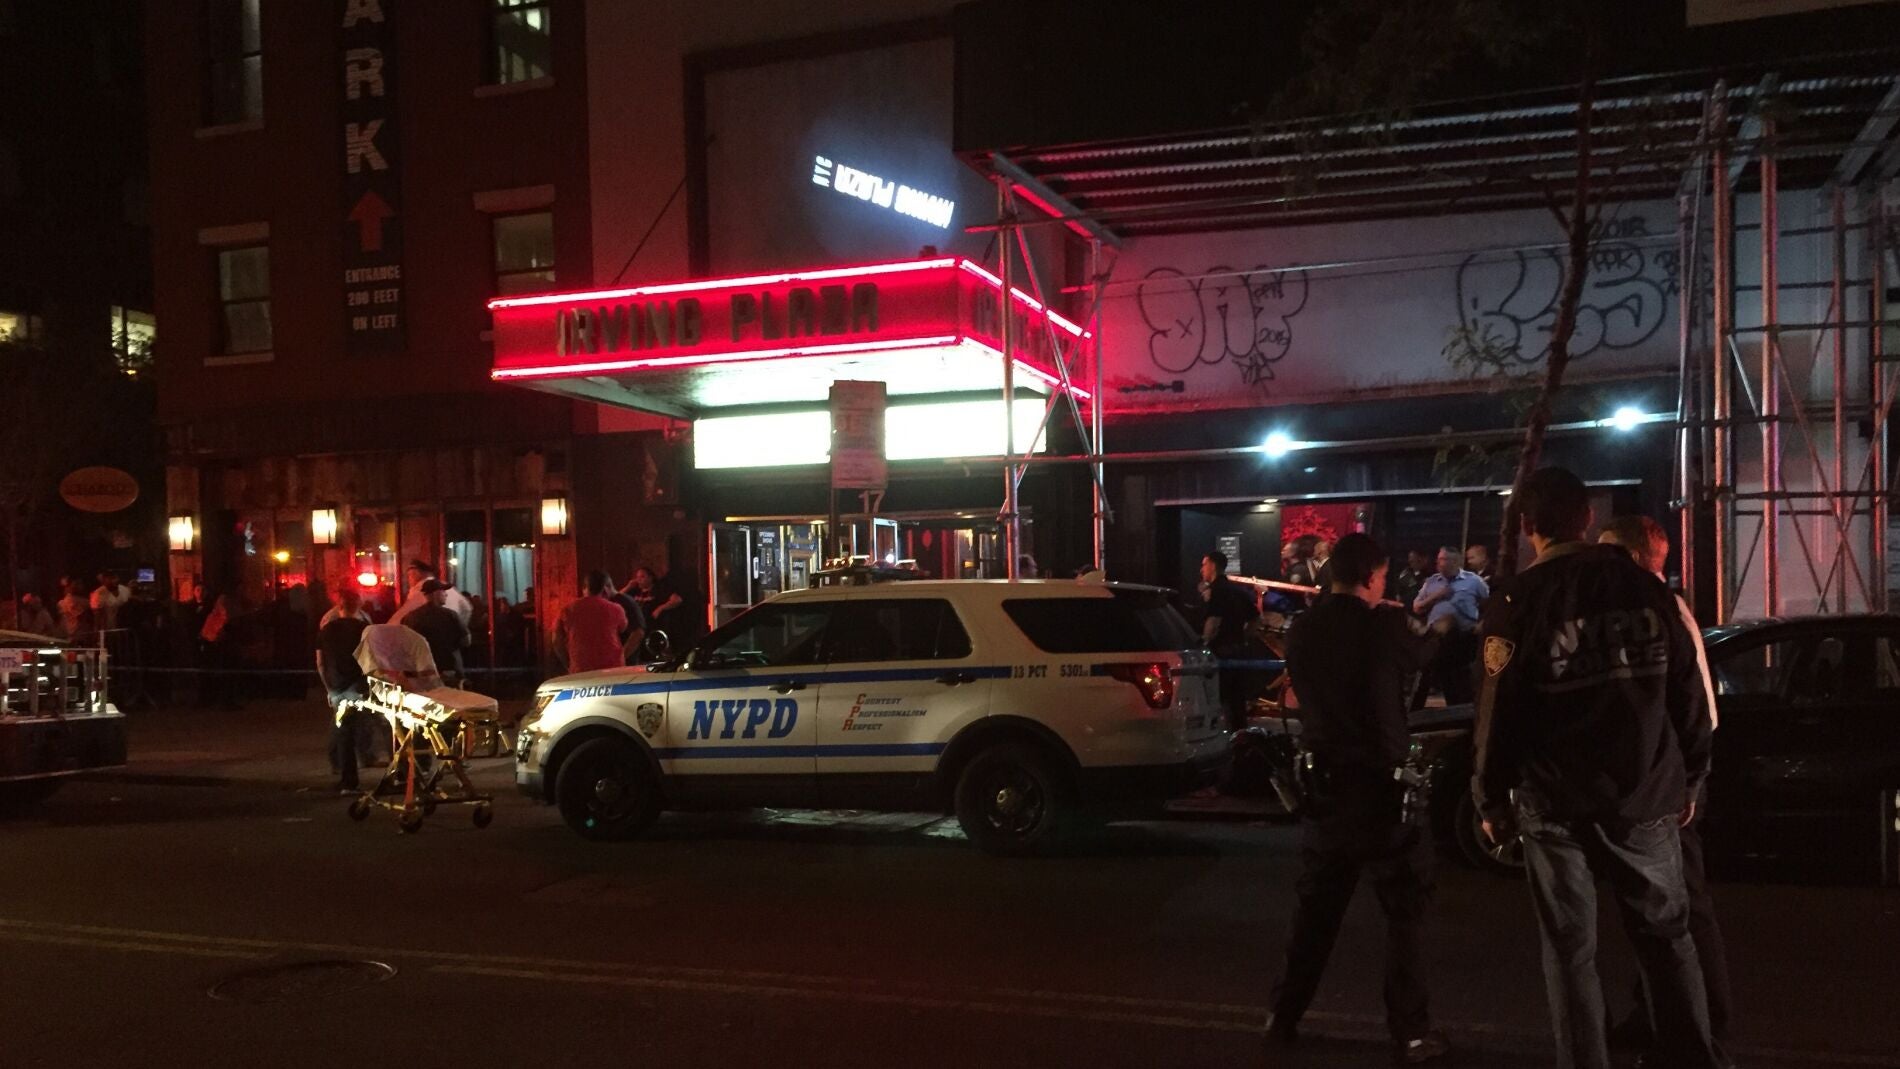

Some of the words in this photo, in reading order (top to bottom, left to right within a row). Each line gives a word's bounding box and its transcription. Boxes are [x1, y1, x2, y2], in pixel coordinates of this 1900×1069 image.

[344, 264, 401, 283] ENTRANCE
[373, 288, 400, 304] FEET
[371, 314, 398, 329] LEFT
[556, 298, 701, 358] IRVING
[731, 281, 880, 342] PLAZA
[858, 489, 886, 514] 17
[1013, 664, 1025, 679] 13
[1027, 664, 1048, 679] PCT
[572, 686, 613, 700] POLICE
[687, 698, 798, 741] NYPD
